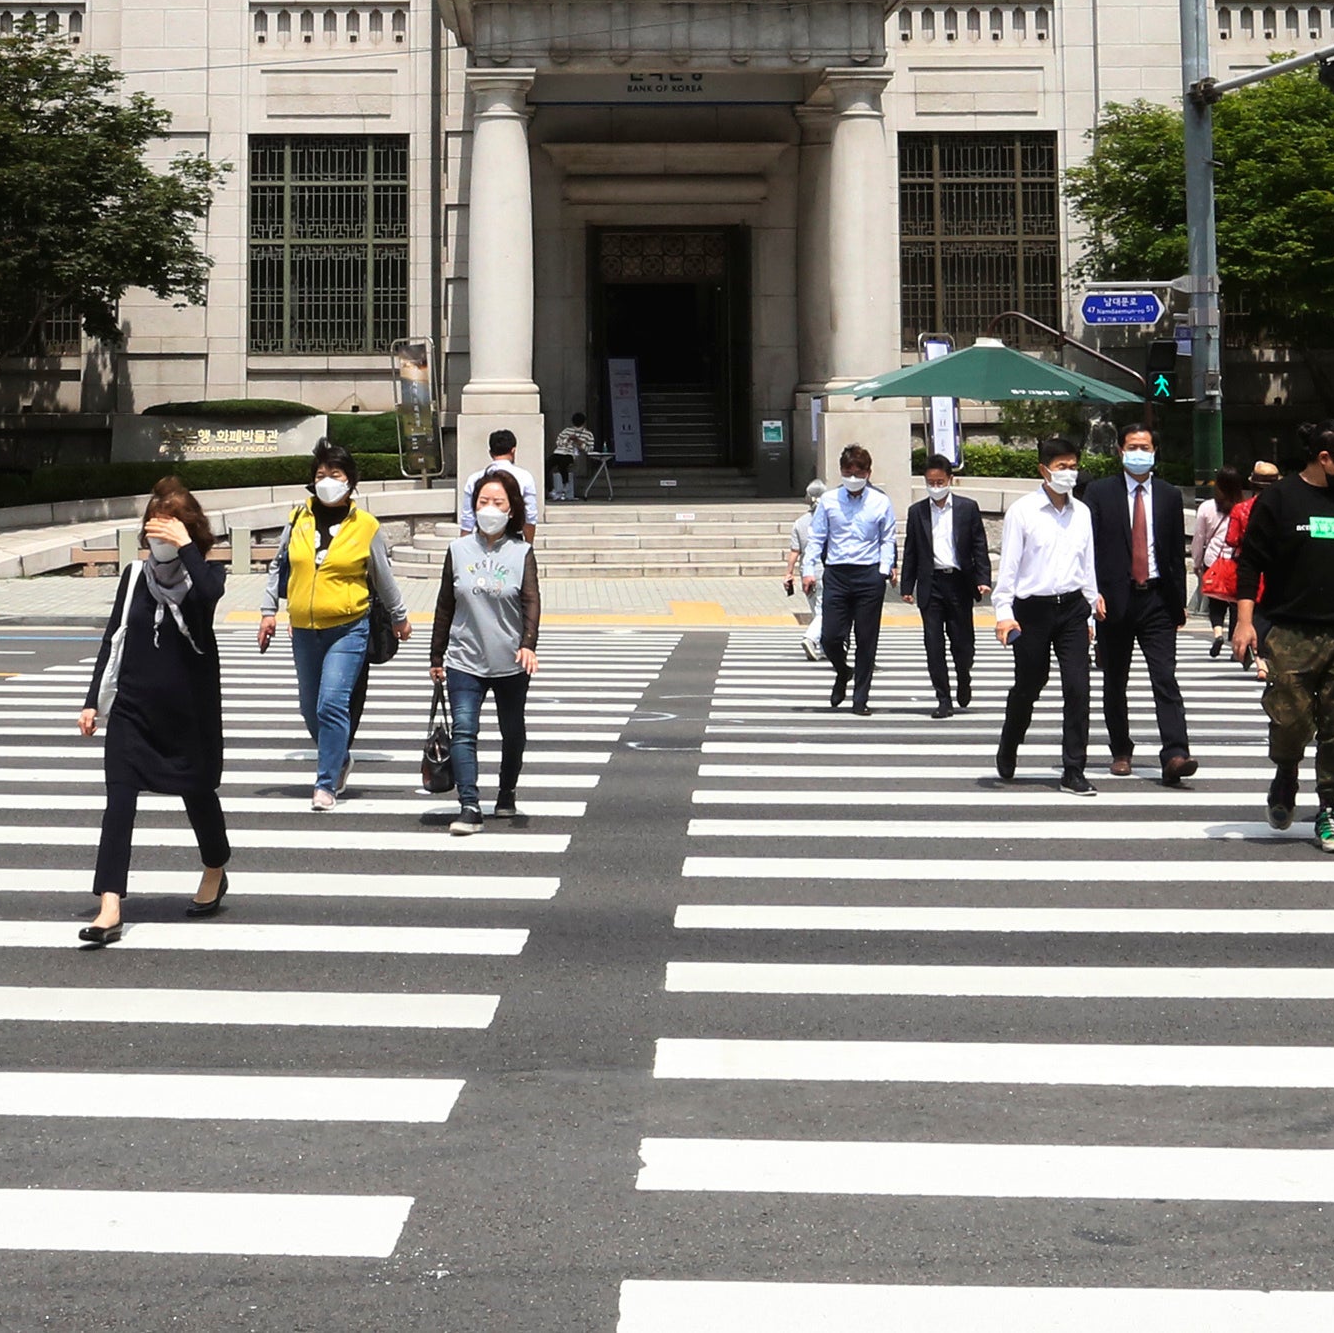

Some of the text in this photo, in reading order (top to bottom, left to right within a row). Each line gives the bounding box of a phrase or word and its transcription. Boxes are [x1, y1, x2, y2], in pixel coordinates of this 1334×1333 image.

[627, 85, 703, 93] BANK OF KOREA
[1103, 297, 1138, 307] 남대문로
[1146, 305, 1154, 313] 51
[160, 429, 278, 444] 국은행 화폐박물관
